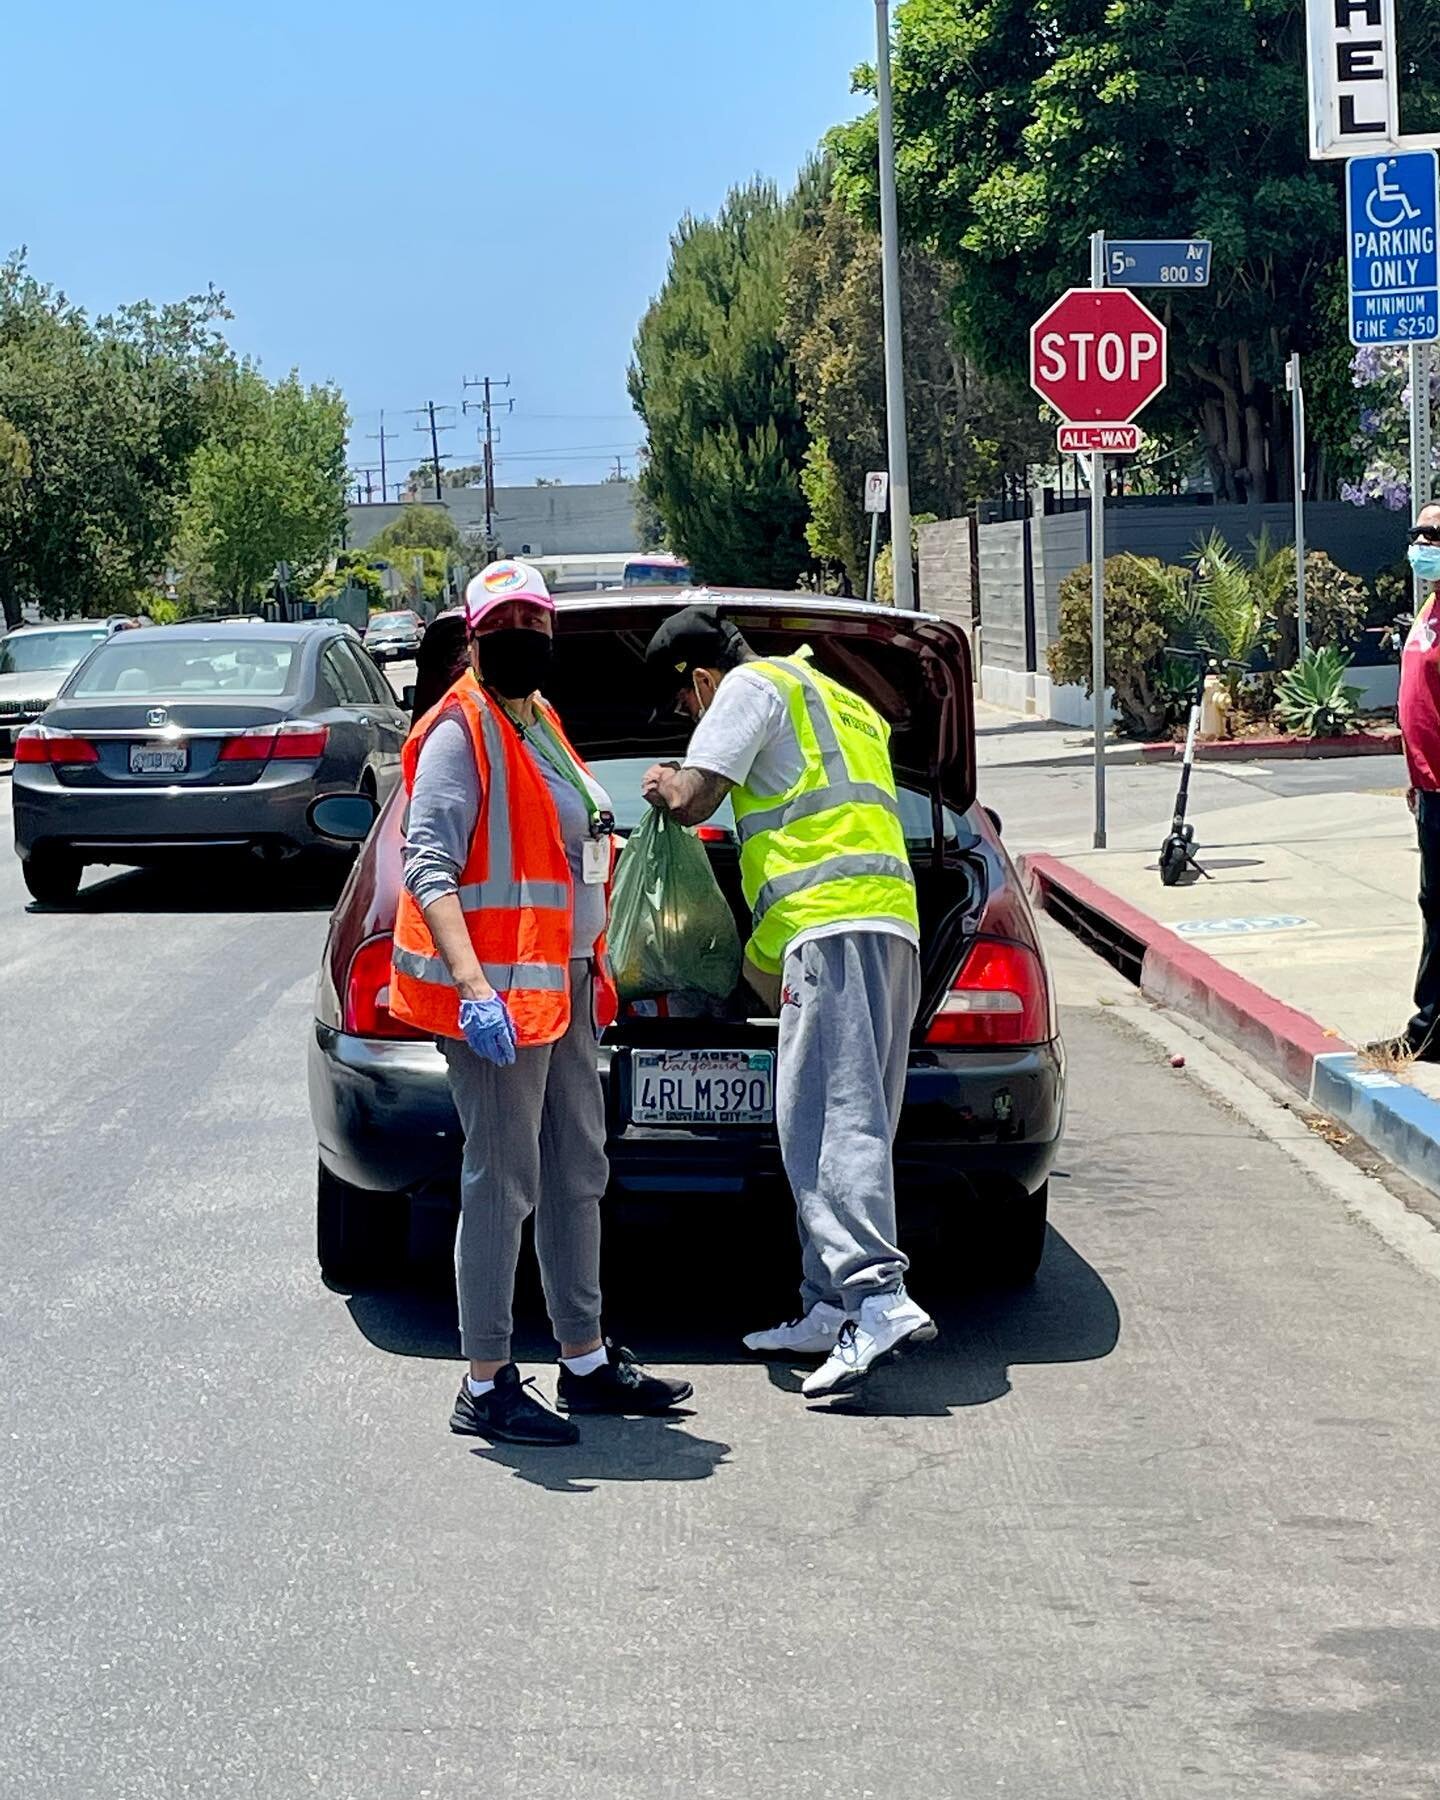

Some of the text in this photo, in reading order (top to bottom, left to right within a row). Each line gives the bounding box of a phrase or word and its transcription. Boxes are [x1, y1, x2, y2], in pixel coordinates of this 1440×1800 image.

[1186, 244, 1204, 259] Av
[1354, 227, 1434, 258] PARKING
[1160, 266, 1204, 282] 800 S
[1370, 259, 1419, 288] ONLY
[1366, 295, 1425, 315] MINIMUM
[1355, 316, 1435, 338] FINE $250
[1039, 332, 1158, 382] STOP
[1062, 430, 1134, 447] ALL-WAY
[641, 1078, 765, 1111] 4RLM390
